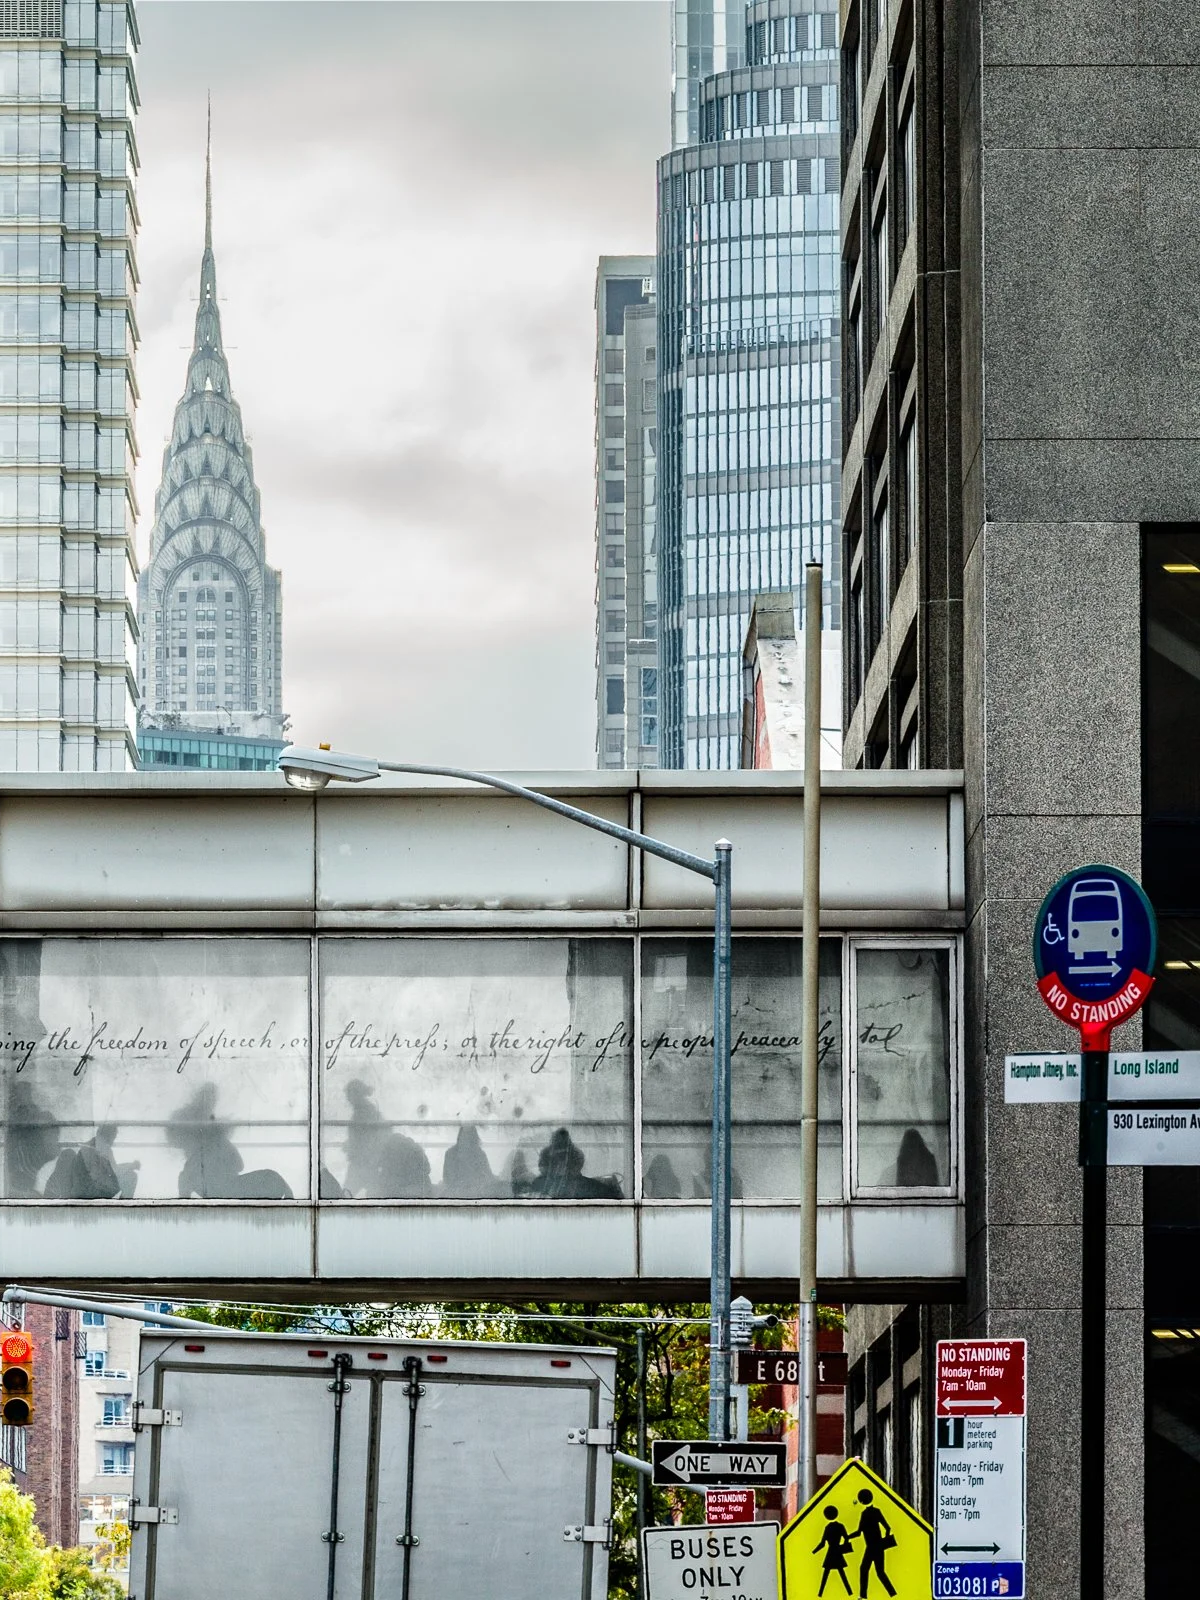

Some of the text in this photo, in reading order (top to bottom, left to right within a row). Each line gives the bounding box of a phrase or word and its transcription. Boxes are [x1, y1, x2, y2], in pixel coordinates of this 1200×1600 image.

[1046, 983, 1142, 1022] NO STANDING
[48, 1026, 81, 1050] the
[74, 1021, 168, 1076] freedom
[177, 1020, 209, 1074] of
[204, 1021, 285, 1058] speech,
[291, 1038, 308, 1049] or
[326, 1021, 355, 1070] of
[348, 1023, 382, 1049] the
[461, 1037, 478, 1049] or
[489, 1019, 524, 1049] the
[525, 1024, 586, 1074] right
[592, 1021, 625, 1073] of
[1011, 1060, 1080, 1081] Hampton Jitney, Inc.
[1113, 1058, 1179, 1078] Long Island
[1113, 1113, 1133, 1129] 930
[1136, 1112, 1187, 1132] Lexington
[941, 1347, 1011, 1362] NO STANDING
[757, 1360, 766, 1381] E
[775, 1360, 798, 1382] 68
[941, 1366, 972, 1379] Monday
[980, 1365, 1004, 1378] Friday
[941, 1380, 958, 1391] 7am
[966, 1379, 986, 1391] 10am
[967, 1420, 984, 1429] hour
[946, 1418, 955, 1446] 1
[967, 1430, 997, 1439] metered
[967, 1440, 993, 1450] parking
[674, 1455, 769, 1473] ONE WAY
[940, 1461, 972, 1474] Monday
[979, 1461, 1004, 1474] Friday
[940, 1475, 961, 1486] 10am
[968, 1475, 984, 1488] 7pm
[708, 1493, 747, 1503] NO STANDING
[940, 1495, 977, 1508] Saturday
[708, 1505, 726, 1513] Monday
[728, 1504, 744, 1513] Friday
[940, 1508, 957, 1520] 9am
[964, 1508, 980, 1521] 7pm
[670, 1536, 754, 1560] BUSES
[937, 1565, 960, 1574] Zone#
[682, 1566, 745, 1588] ONLY
[937, 1577, 987, 1595] 103081
